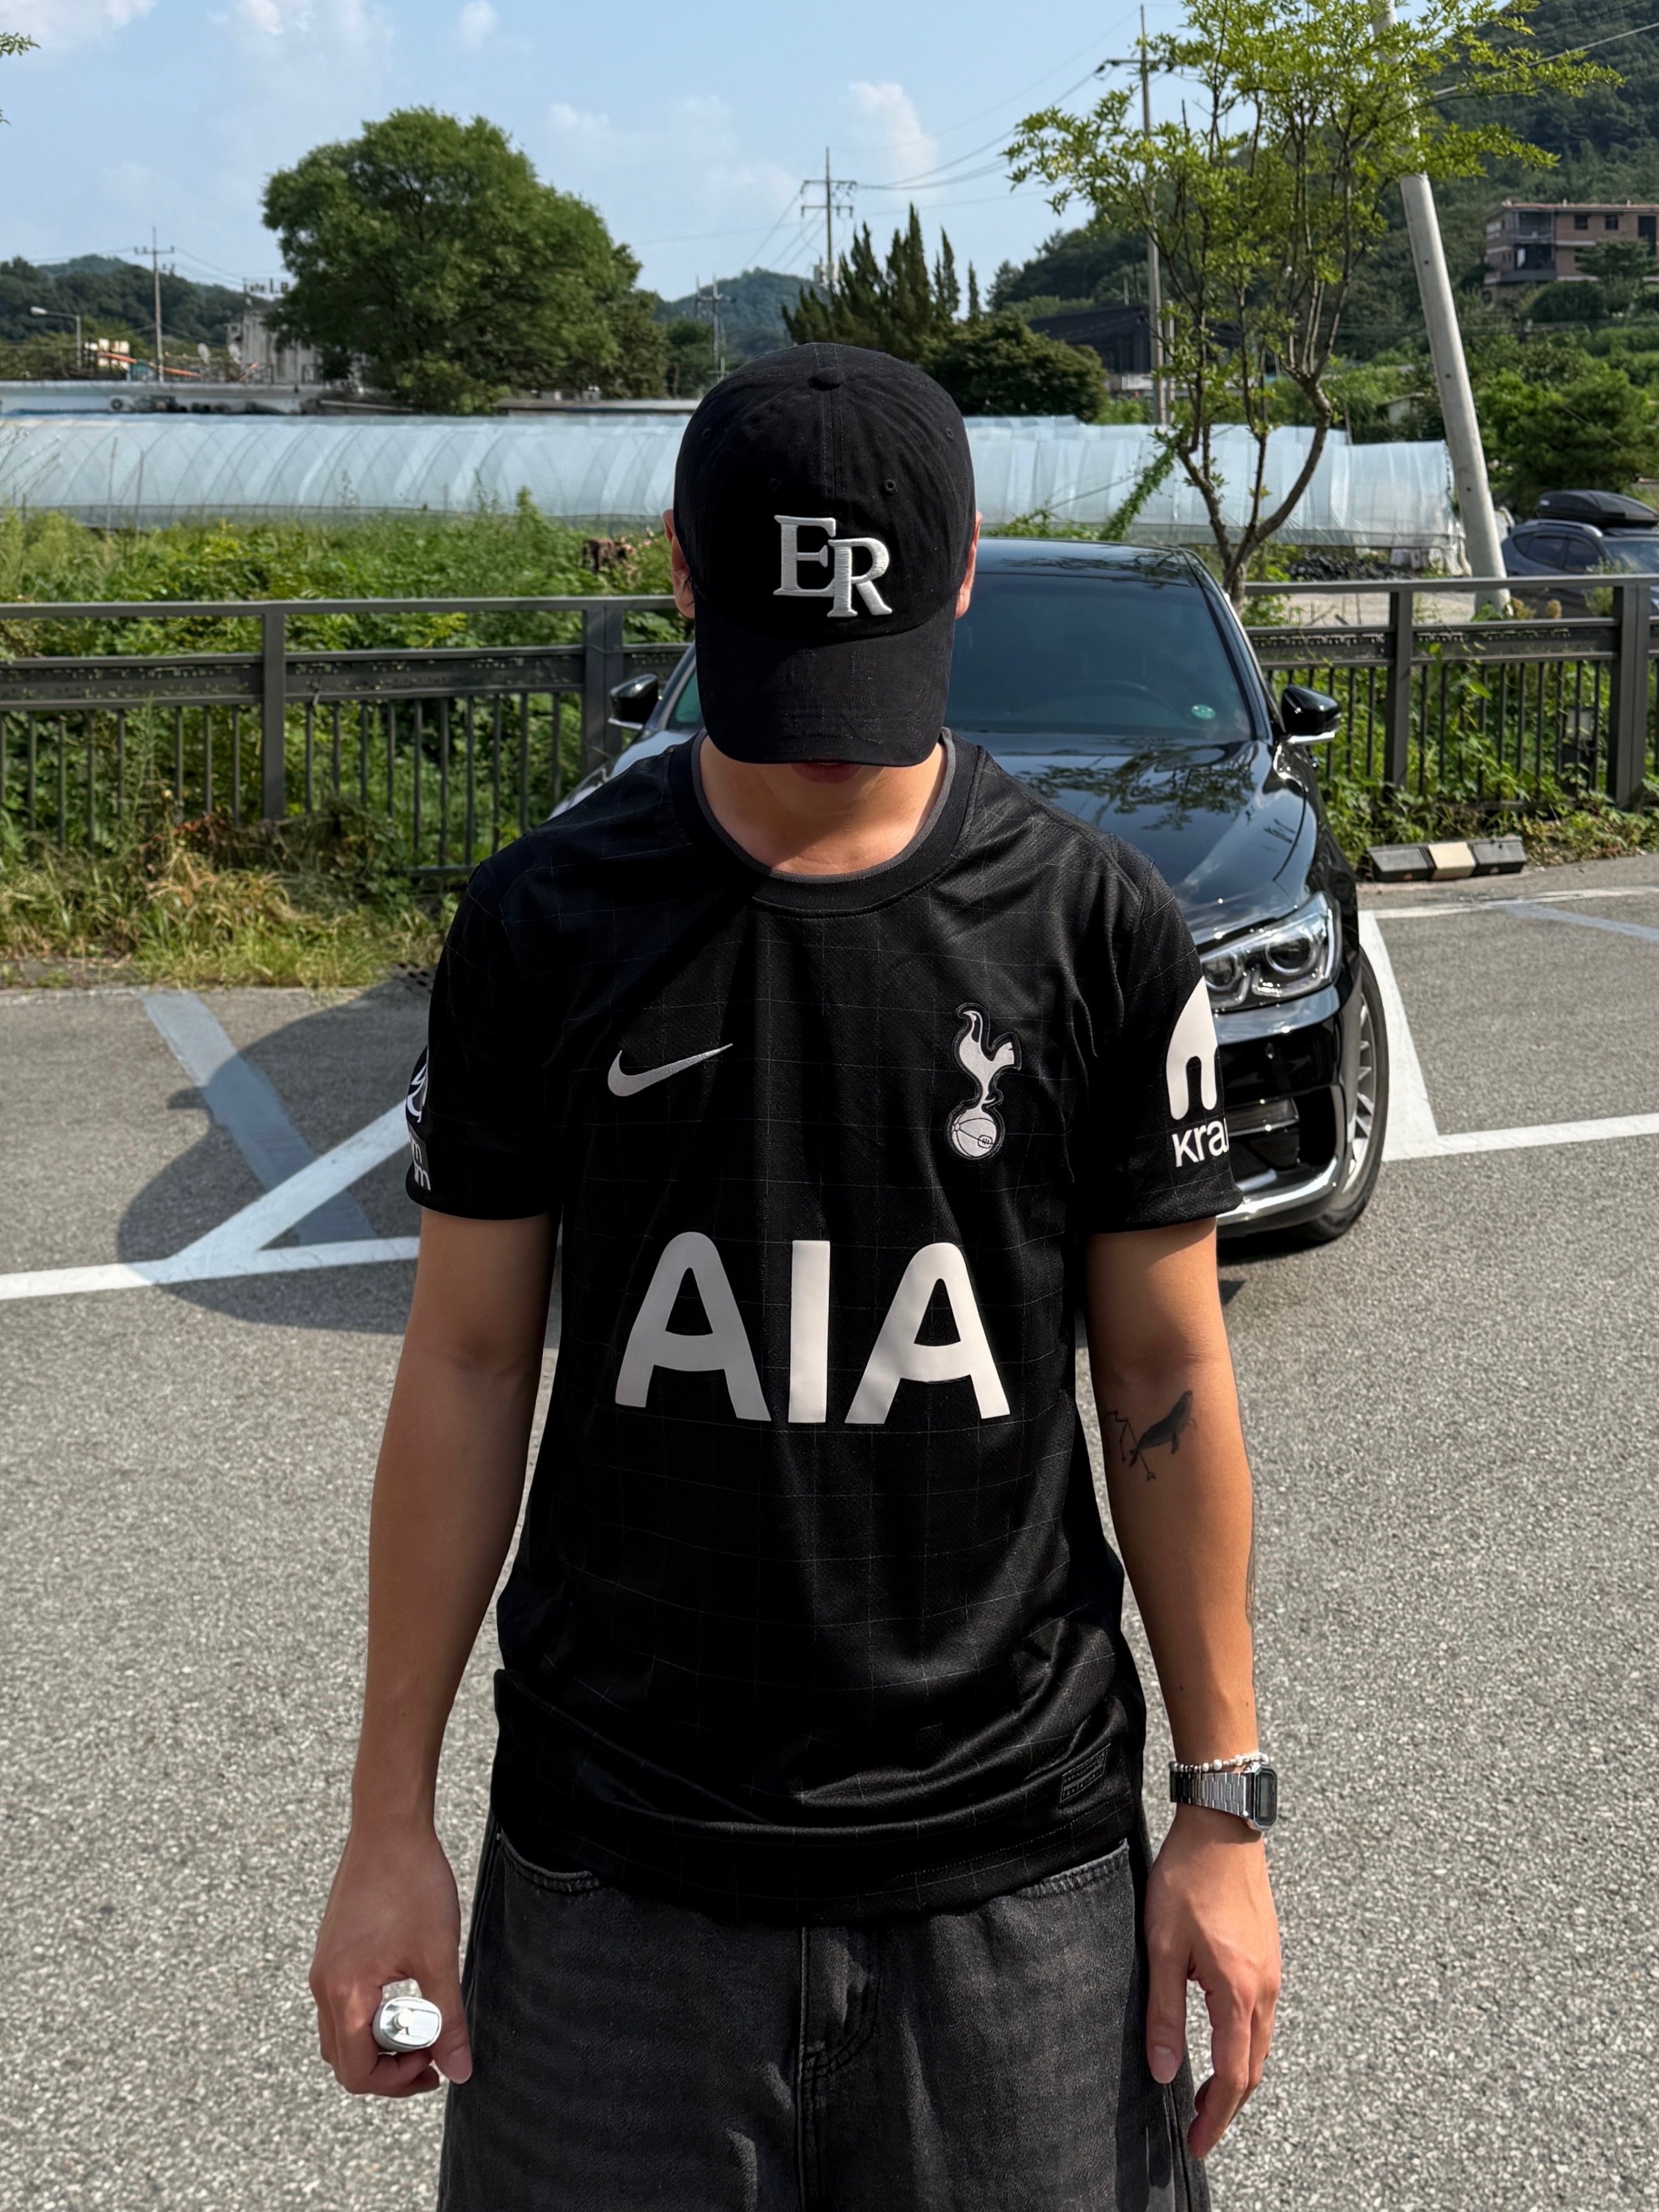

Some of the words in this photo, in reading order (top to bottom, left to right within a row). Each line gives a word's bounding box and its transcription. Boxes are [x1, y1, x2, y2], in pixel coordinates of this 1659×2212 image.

[773, 514, 893, 618] ER
[1172, 1118, 1229, 1167] kra
[615, 1231, 1011, 1424] AIA
